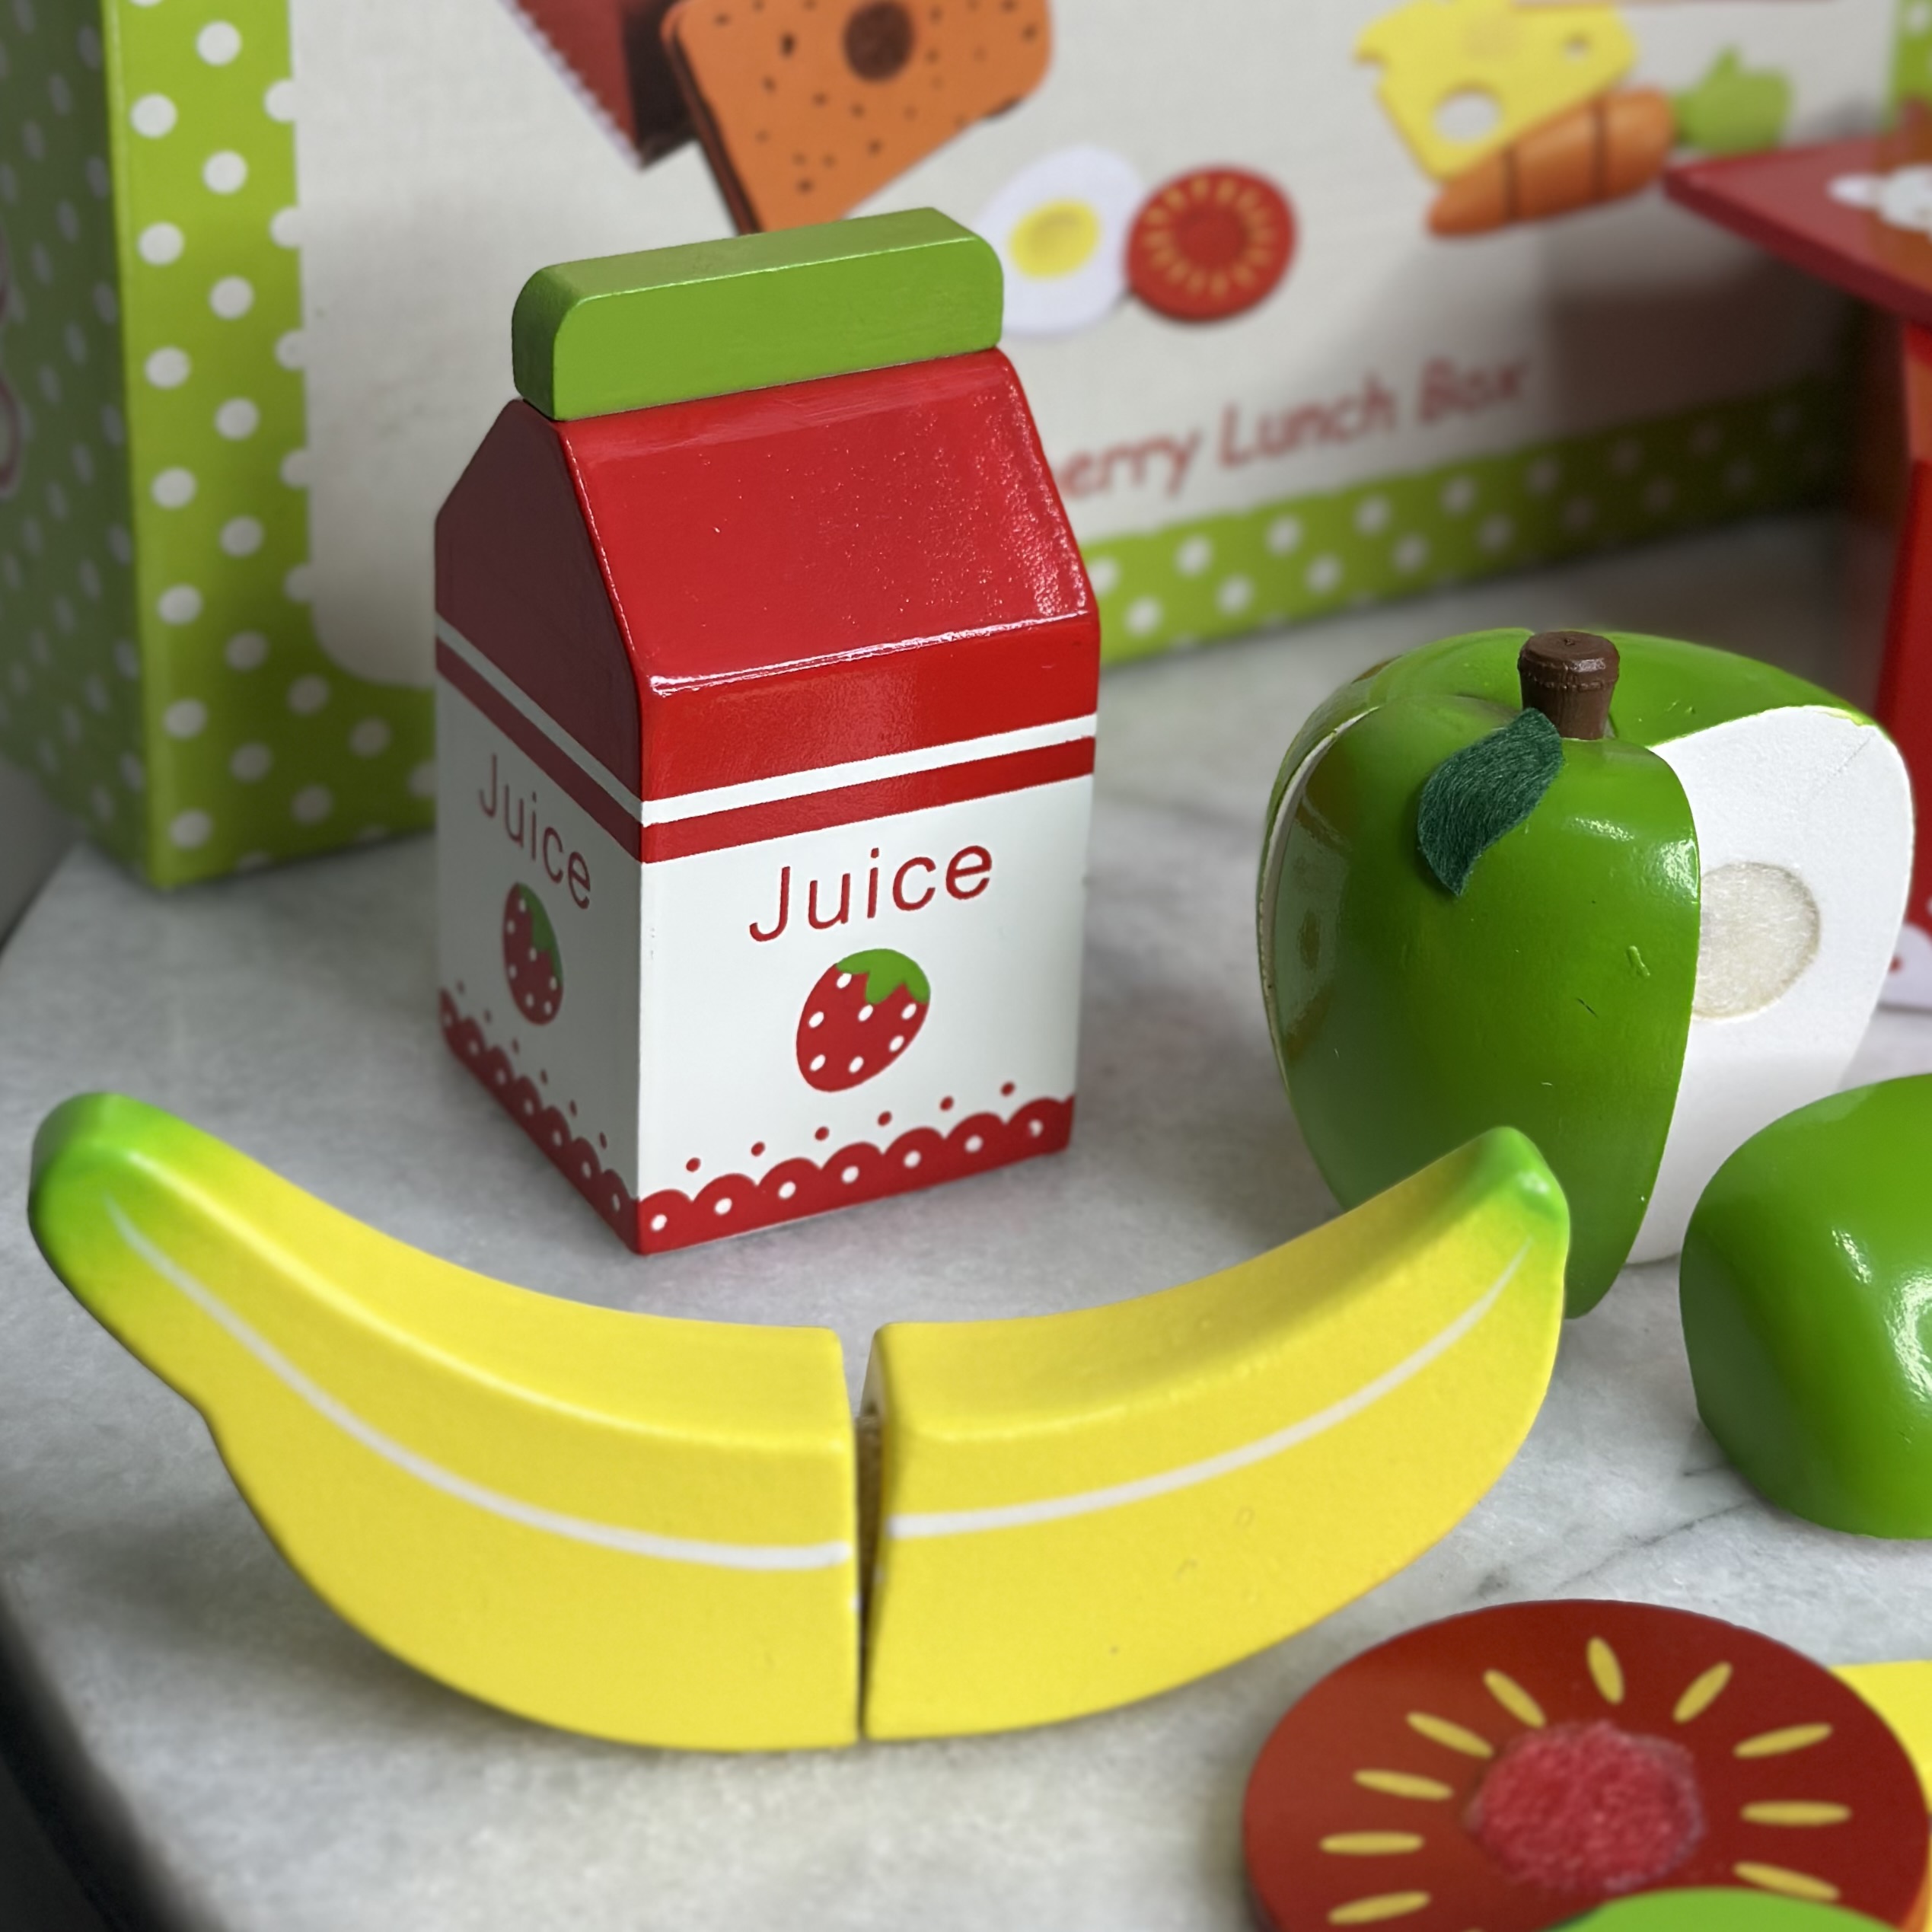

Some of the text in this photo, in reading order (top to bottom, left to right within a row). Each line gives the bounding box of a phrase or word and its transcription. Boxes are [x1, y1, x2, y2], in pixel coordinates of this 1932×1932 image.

[1057, 353, 1528, 499] erry Lunch Box
[478, 754, 591, 910] Juice
[749, 845, 993, 942] Juice
